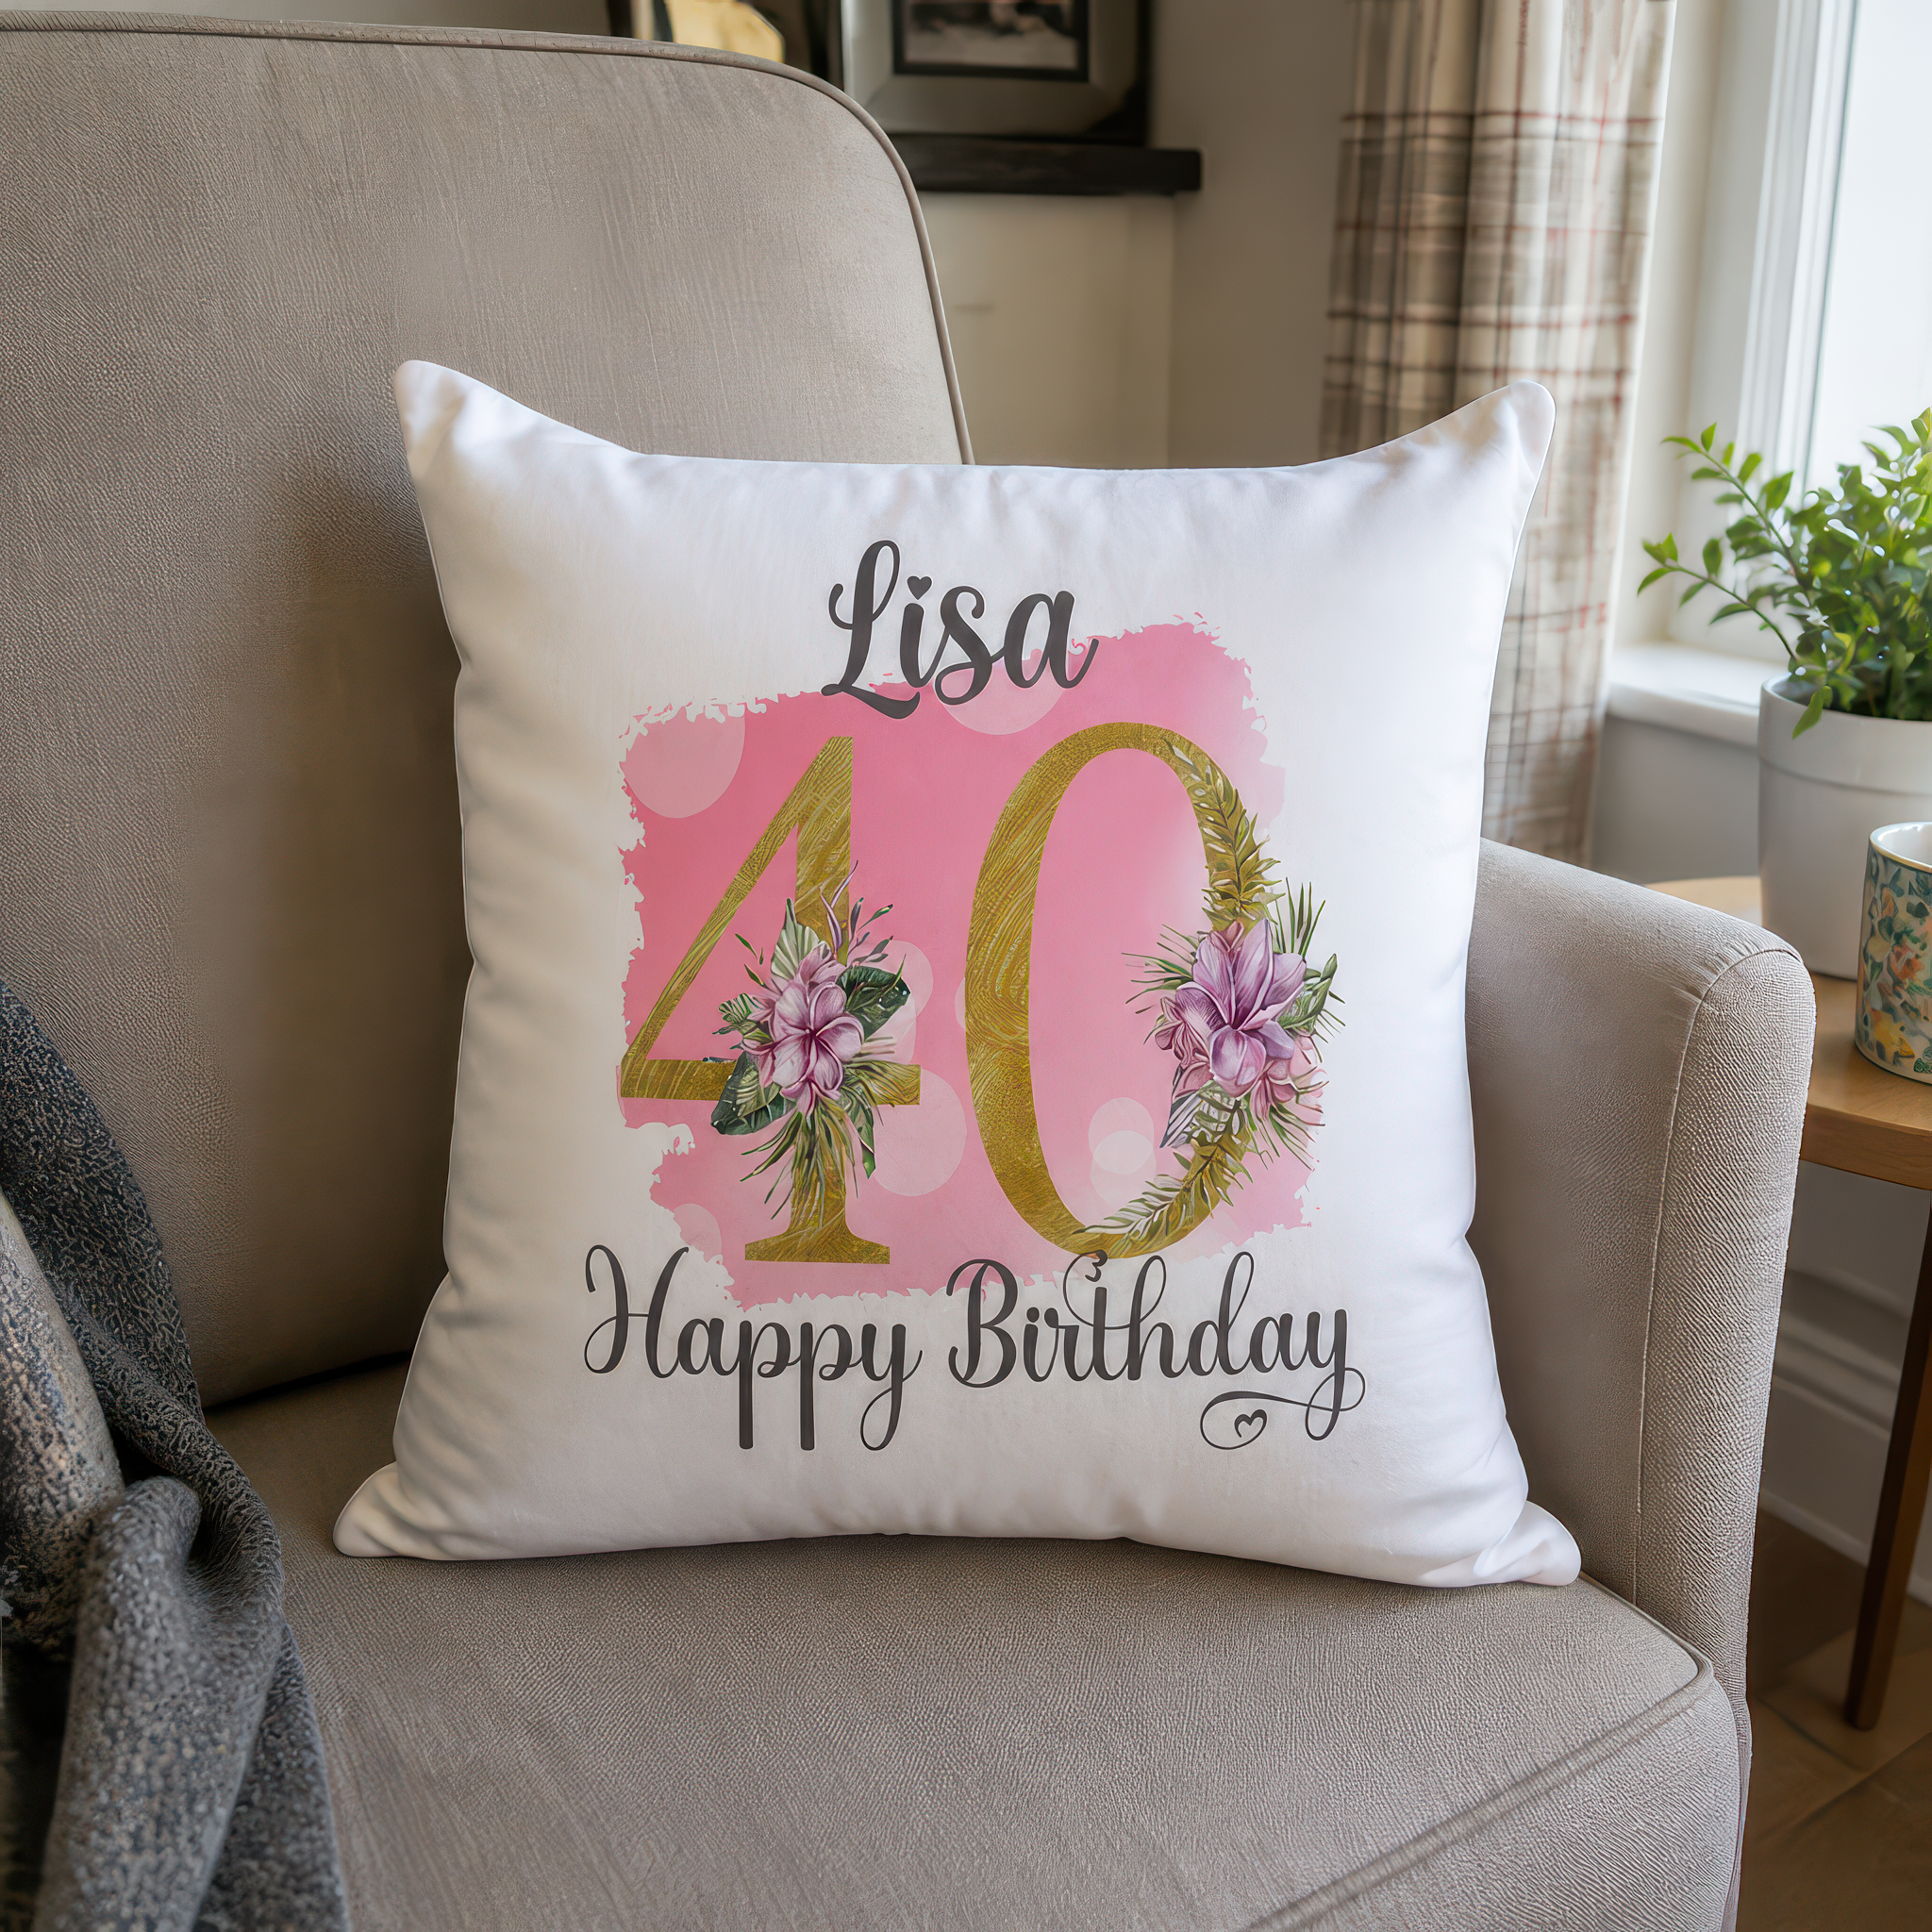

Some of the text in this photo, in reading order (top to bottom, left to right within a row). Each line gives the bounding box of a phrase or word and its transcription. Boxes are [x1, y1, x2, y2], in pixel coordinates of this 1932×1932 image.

[822, 541, 1100, 720] Lisa
[619, 722, 1321, 1265] 40
[584, 1245, 1367, 1452] Happy Birthday
